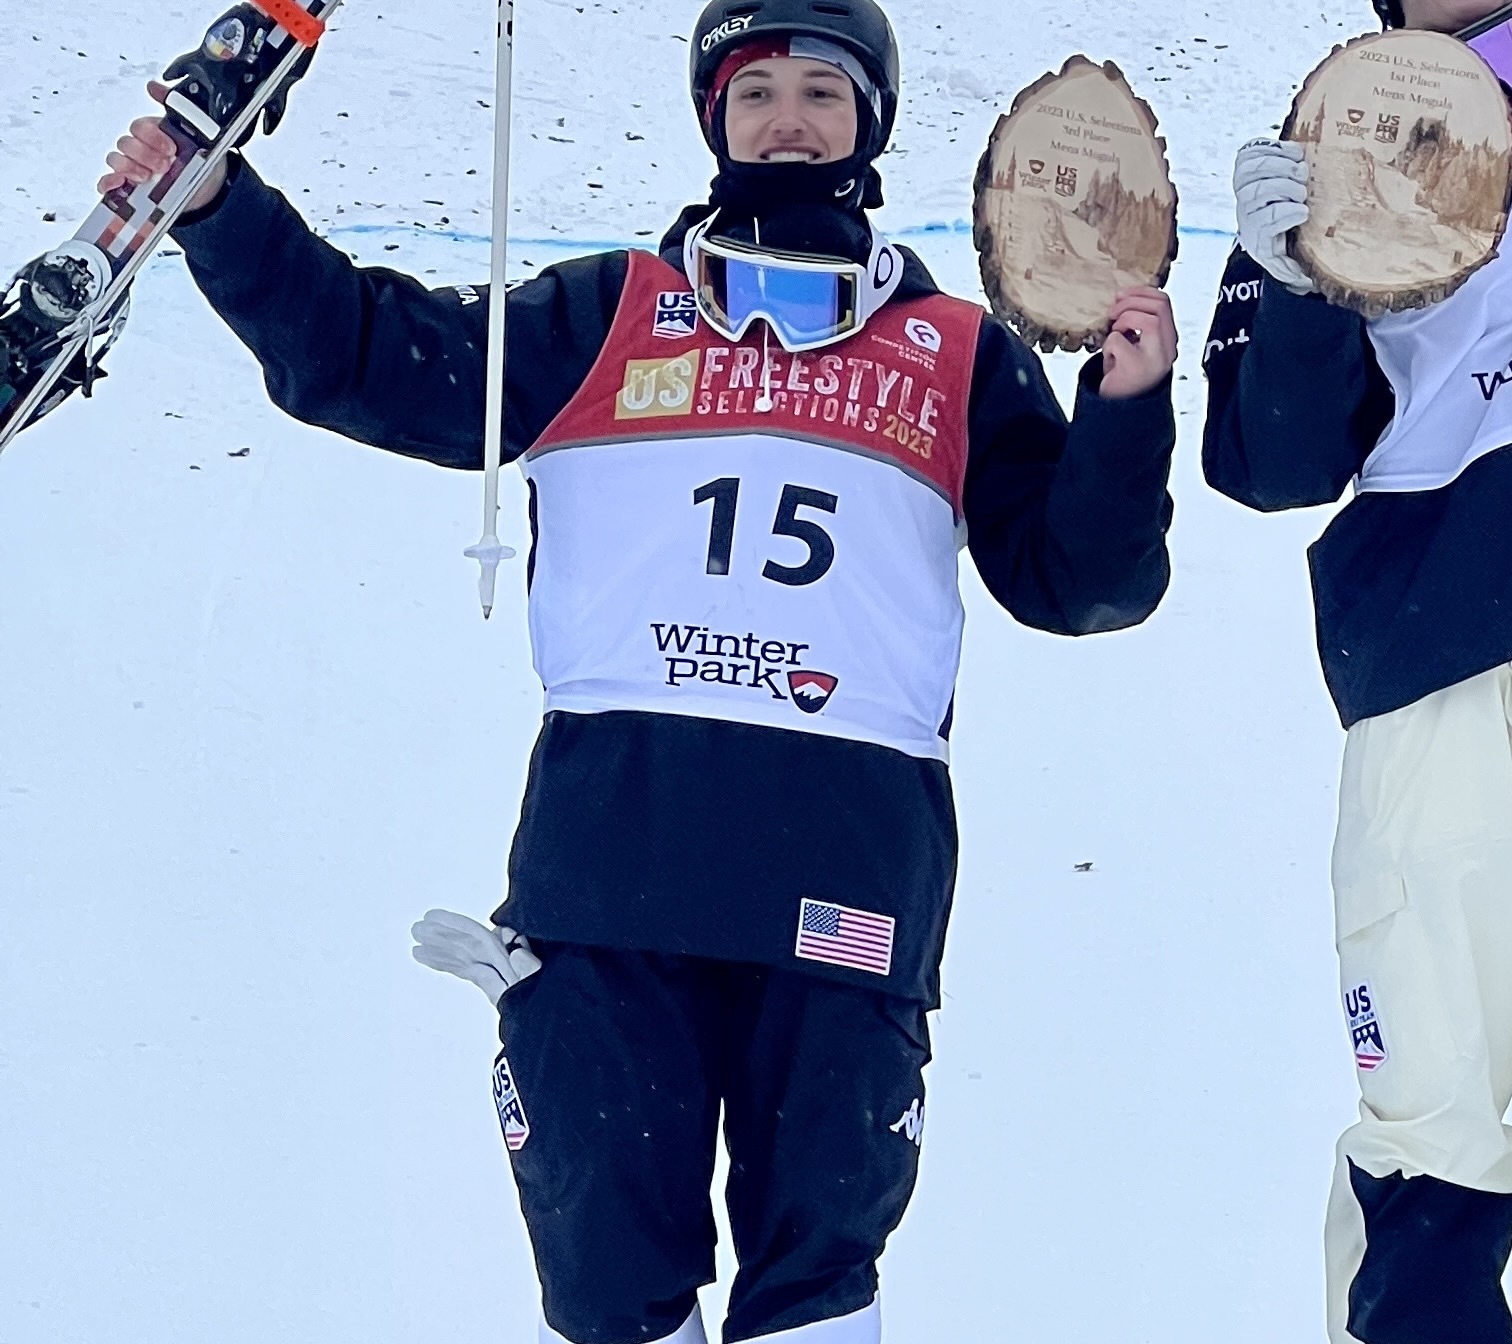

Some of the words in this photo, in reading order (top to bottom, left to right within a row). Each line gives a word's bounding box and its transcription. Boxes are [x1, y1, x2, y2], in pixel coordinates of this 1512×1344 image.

[1360, 50, 1390, 64] 2023
[1420, 61, 1480, 80] Selections
[1391, 71, 1405, 82] 1st
[1410, 74, 1441, 88] Place
[1372, 86, 1405, 100] Mens
[1410, 93, 1453, 110] Moguls
[1037, 104, 1064, 118] 2023
[1090, 115, 1142, 136] Selections
[1063, 125, 1081, 137] 3rd
[1083, 129, 1111, 143] Place
[1379, 113, 1401, 126] US
[1050, 140, 1079, 155] Mens
[1057, 164, 1078, 178] US
[659, 293, 697, 309] US
[622, 358, 692, 411] US
[700, 346, 946, 437] FREESTYLE
[882, 414, 935, 460] 2023
[693, 477, 839, 586] 15
[650, 623, 809, 666] Winter
[1345, 985, 1372, 1018] US
[493, 1063, 511, 1098] US
